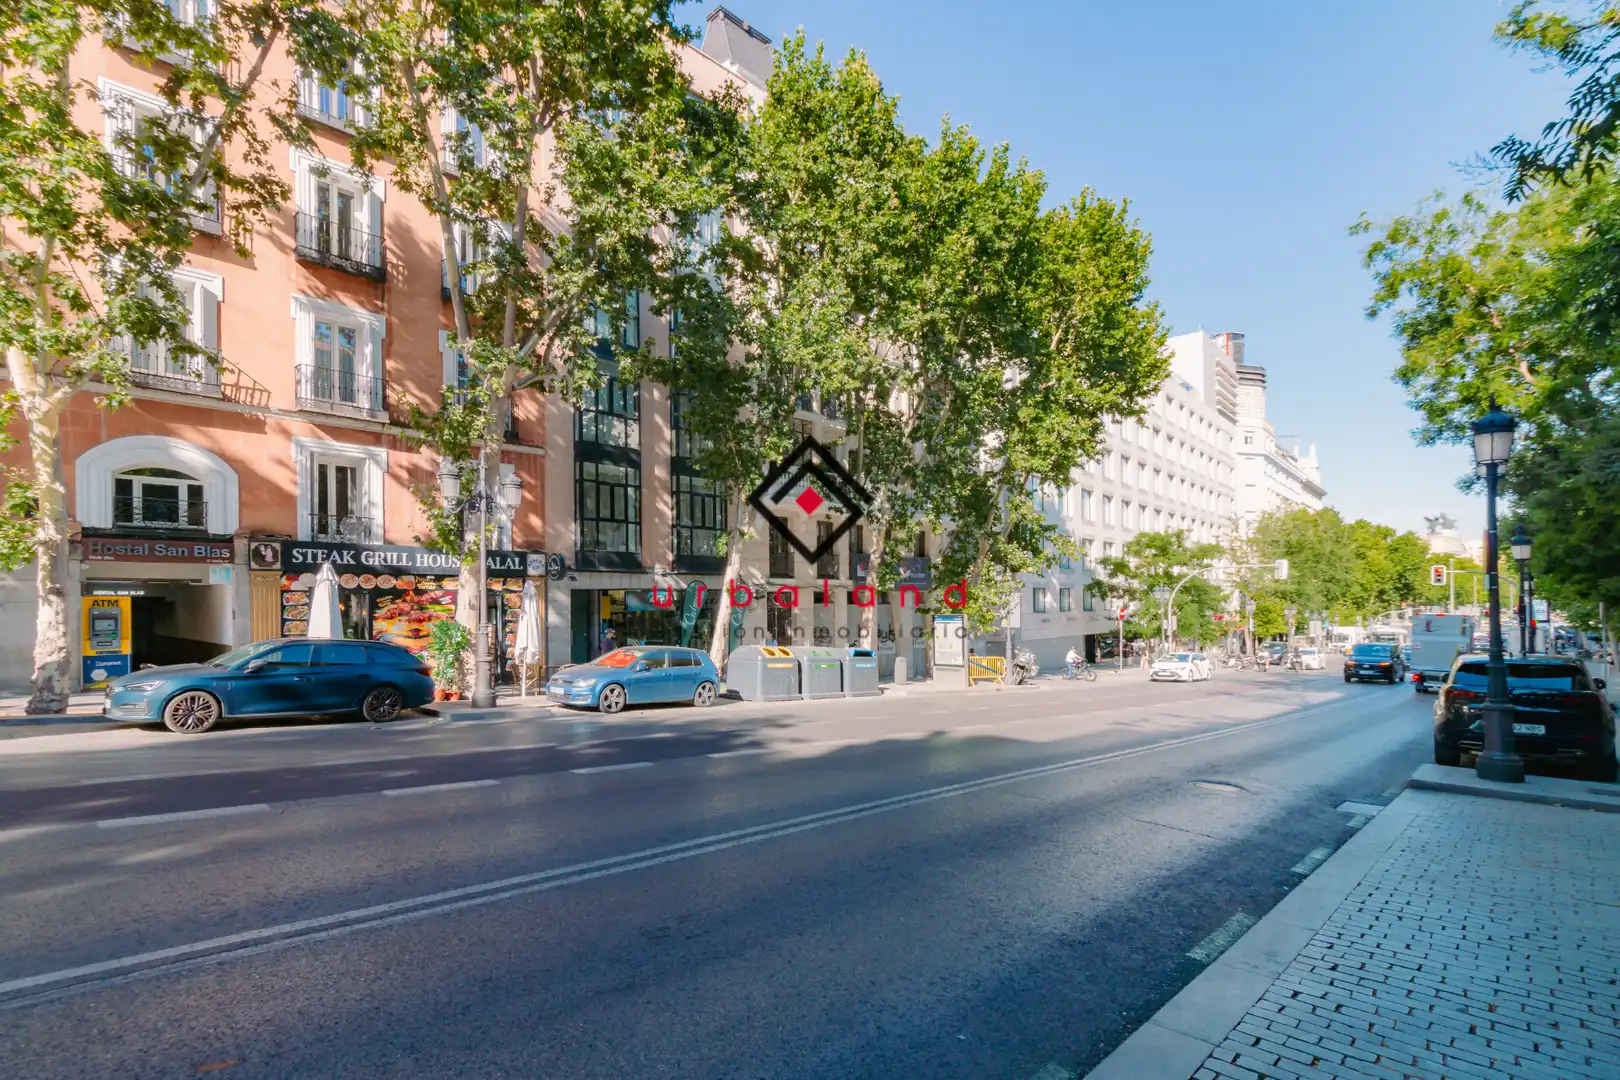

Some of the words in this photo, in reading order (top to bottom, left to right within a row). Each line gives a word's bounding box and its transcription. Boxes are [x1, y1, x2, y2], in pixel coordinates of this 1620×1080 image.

[88, 541, 148, 556] Hostal
[154, 543, 188, 557] San
[193, 545, 230, 558] Blas
[292, 548, 356, 564] STEAK
[361, 550, 412, 566] GRILL
[416, 553, 461, 568] HOUS
[485, 556, 524, 570] ALAL
[92, 599, 119, 607] ATM
